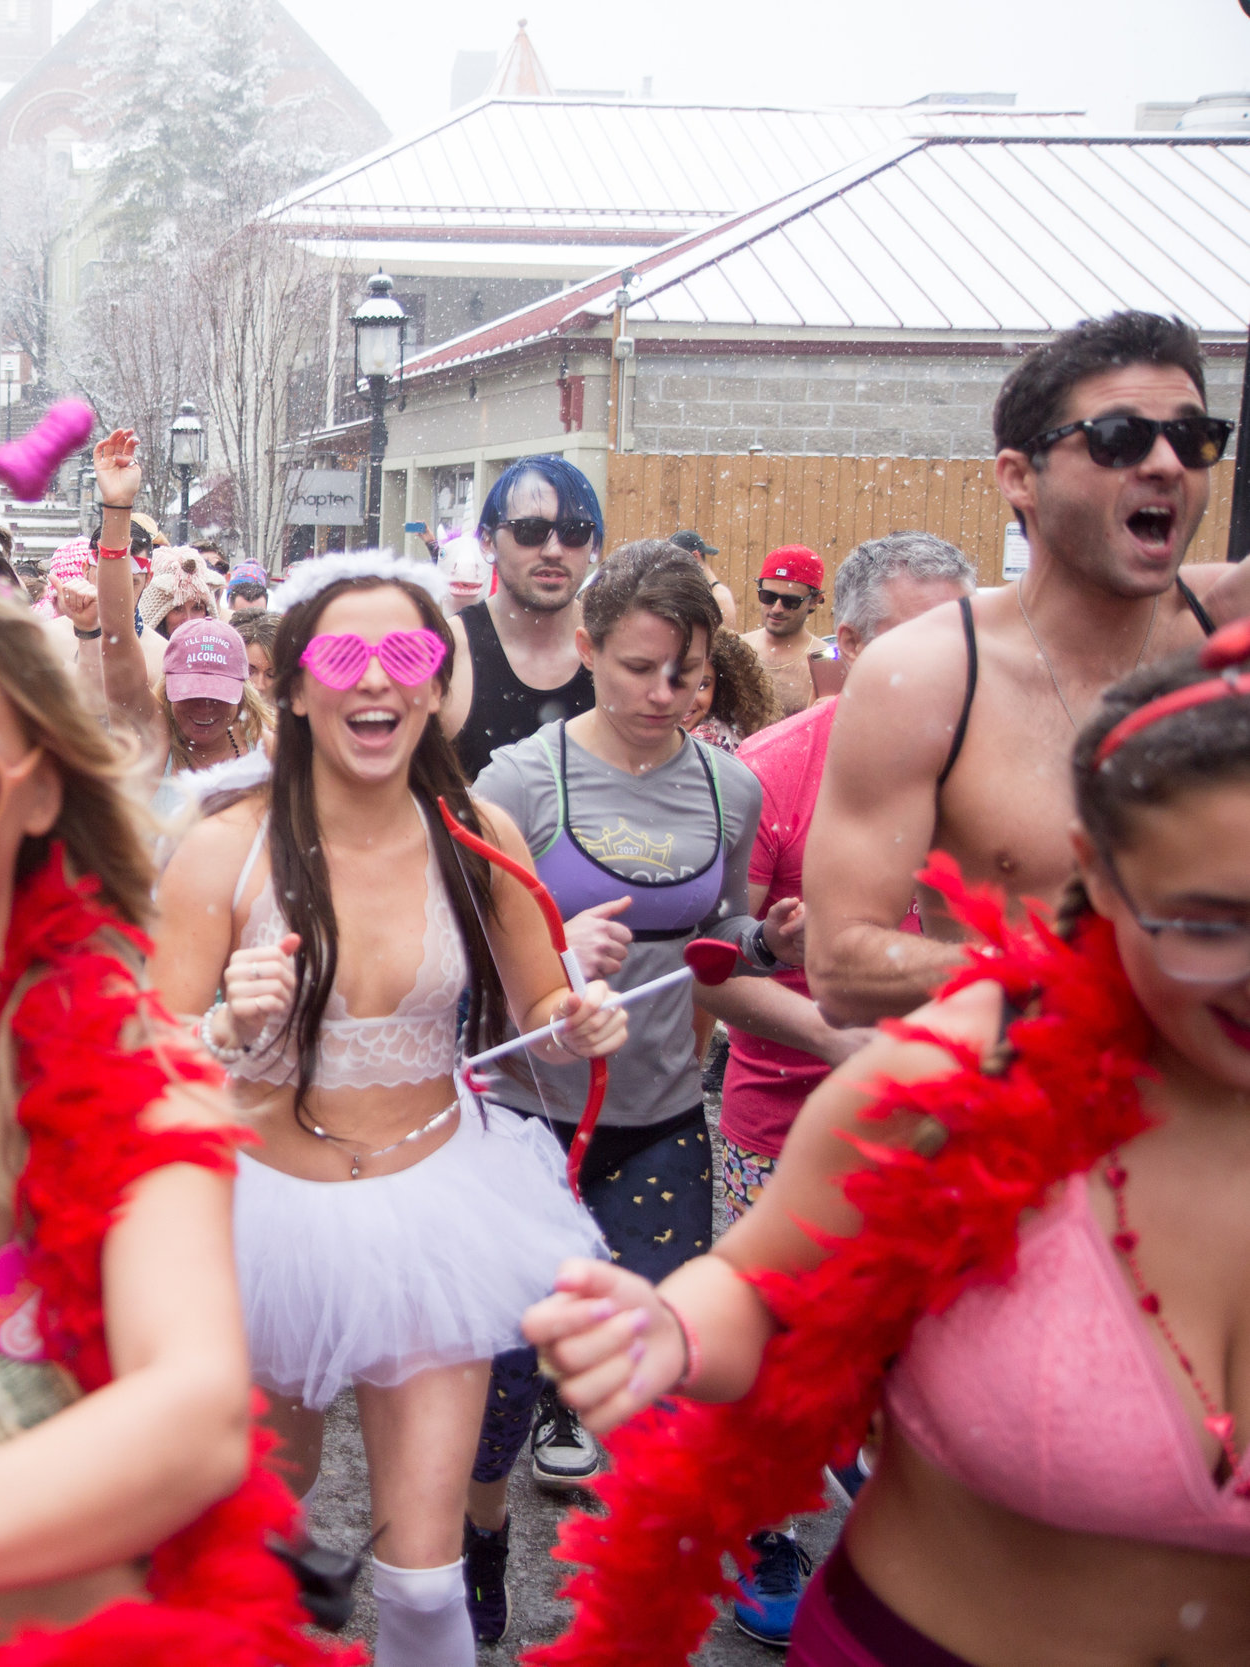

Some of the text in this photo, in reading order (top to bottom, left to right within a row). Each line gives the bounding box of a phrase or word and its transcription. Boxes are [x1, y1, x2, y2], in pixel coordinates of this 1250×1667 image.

[184, 635, 230, 649] I'LL BRING
[186, 652, 227, 665] ALCOHOL
[617, 845, 640, 855] 2017
